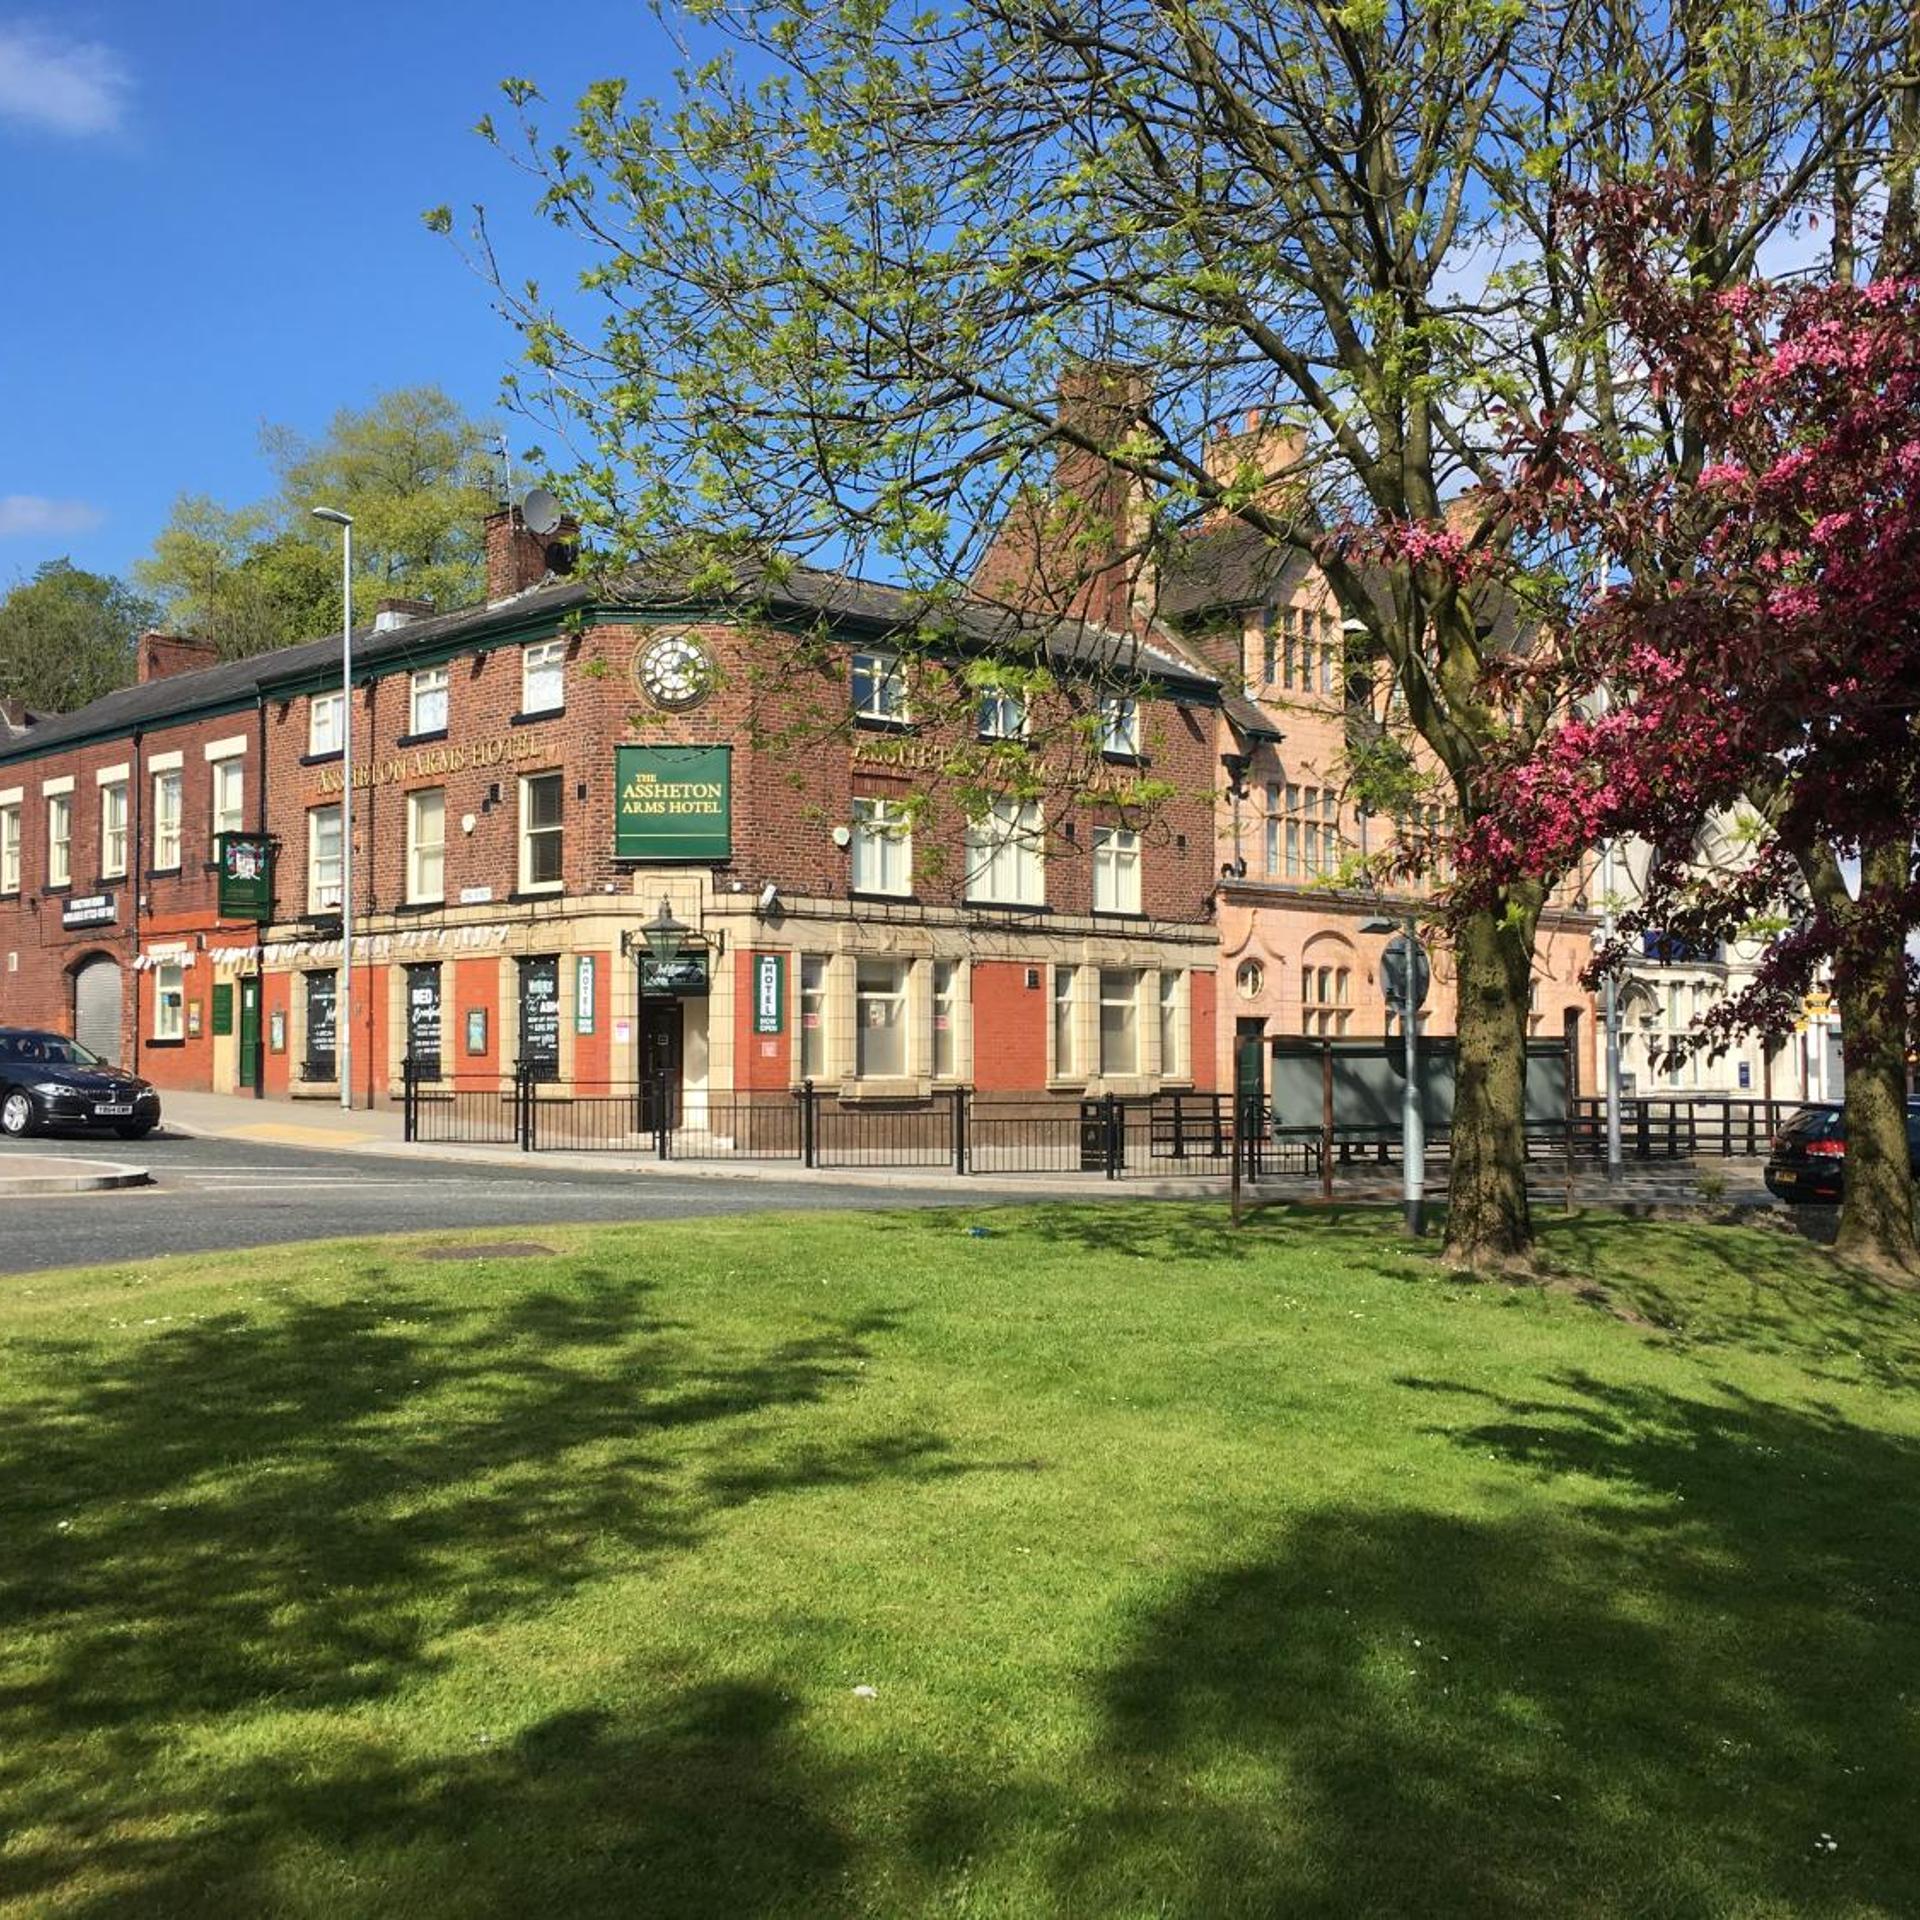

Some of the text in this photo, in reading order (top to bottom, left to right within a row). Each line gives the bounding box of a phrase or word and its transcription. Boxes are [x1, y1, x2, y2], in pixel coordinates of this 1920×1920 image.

[414, 747, 464, 777] ARMS
[473, 734, 540, 766] HOTEL
[635, 773, 657, 783] THE
[622, 783, 722, 798] ASSHETON
[622, 801, 722, 813] ARMS HOTEL
[764, 965, 773, 1015] HOTEL
